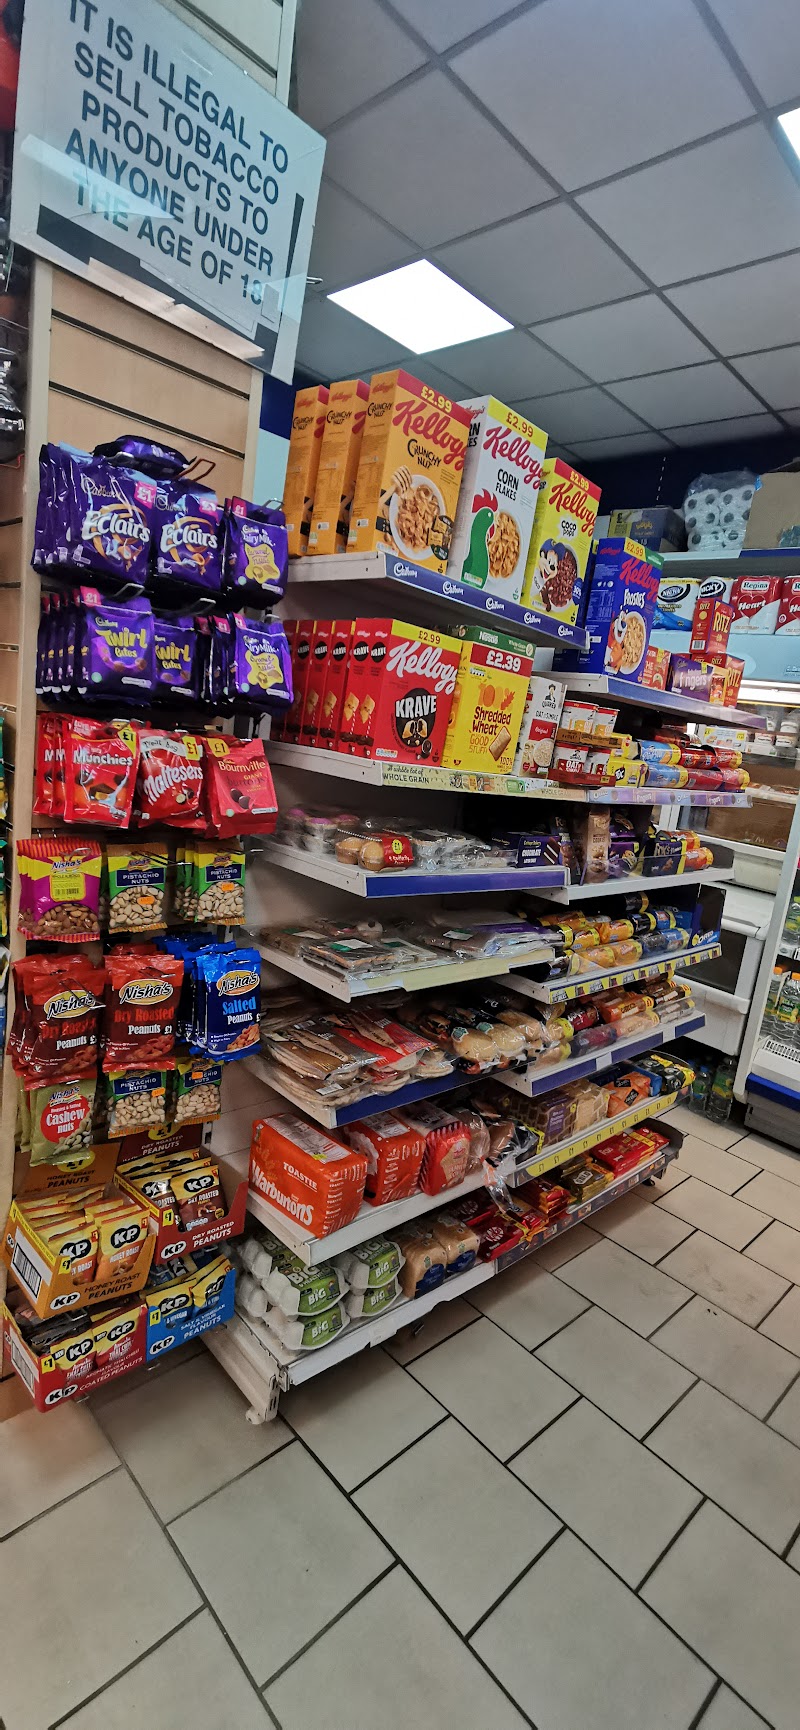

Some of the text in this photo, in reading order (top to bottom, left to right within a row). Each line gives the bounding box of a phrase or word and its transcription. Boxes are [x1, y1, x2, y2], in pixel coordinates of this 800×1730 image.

[69, 0, 288, 174] IT IS ILLEGAL TO
[74, 41, 279, 205] SELL TOBACCO
[82, 90, 269, 235] PRODUCTS TO
[65, 128, 274, 276] ANYONE UNDER
[73, 167, 262, 305] THE AGE OF 18
[421, 385, 452, 413] £2.99
[506, 412, 534, 437] £2.99
[407, 438, 442, 467] CRUNCHY
[417, 456, 432, 469] NUT
[497, 469, 519, 491] CORN
[570, 471, 590, 491] £2.99
[496, 482, 517, 501] FLAKES
[82, 510, 150, 542] Eclairs
[160, 524, 218, 552] Eclairs
[626, 541, 644, 557] £2.99
[394, 562, 418, 578] Cadbury
[442, 581, 464, 596] Cadbury
[743, 581, 768, 591] Regina
[86, 593, 97, 603] £1
[485, 597, 505, 611] Cadbury
[523, 611, 541, 624] Cadbury
[713, 611, 731, 634] RITZ
[95, 627, 148, 648] Twirl
[418, 630, 441, 645] £2.99
[486, 650, 521, 673] £2.39
[395, 695, 437, 719] KRAVE
[474, 706, 512, 725] Shredded
[122, 731, 134, 741] £1
[472, 719, 498, 736] Wheat
[186, 741, 198, 755] £1
[214, 742, 226, 753] £1
[73, 749, 133, 766] Munchies
[218, 759, 267, 773] Bournville
[143, 765, 204, 806] Maltesers
[382, 773, 429, 784] WHOLE GRAIN
[51, 859, 81, 870] Nisha's
[120, 982, 173, 1004] Nisha's
[218, 972, 259, 997] Nisha's
[222, 996, 256, 1015] Salted
[227, 1012, 253, 1025] Peanuts
[128, 1023, 161, 1035] Peanuts
[56, 1035, 87, 1051] Peanuts
[46, 1108, 85, 1127] Cashew
[57, 1124, 75, 1135] nuts
[142, 1140, 180, 1155] PEANUTS
[47, 1176, 90, 1188] PEANUTS
[187, 1176, 212, 1191] KP
[283, 1161, 317, 1189] TOASTIE
[252, 1159, 314, 1226] Warburtons
[165, 1211, 172, 1222] £1
[207, 1221, 234, 1233] ROASTED
[114, 1227, 139, 1246] KP
[193, 1228, 232, 1248] PEANUTS
[62, 1241, 88, 1258] KP
[164, 1243, 184, 1257] KP
[84, 1281, 113, 1292] HONEY
[88, 1282, 133, 1300] PEANUTS
[53, 1294, 78, 1307] KP
[160, 1296, 187, 1313] KP
[151, 1311, 159, 1321] £1
[110, 1321, 133, 1340] KP
[183, 1315, 221, 1340] PEANUTS
[69, 1340, 92, 1360] KP
[152, 1336, 173, 1353] KP
[80, 1372, 110, 1391] COATED
[111, 1356, 143, 1376] PEANUTS
